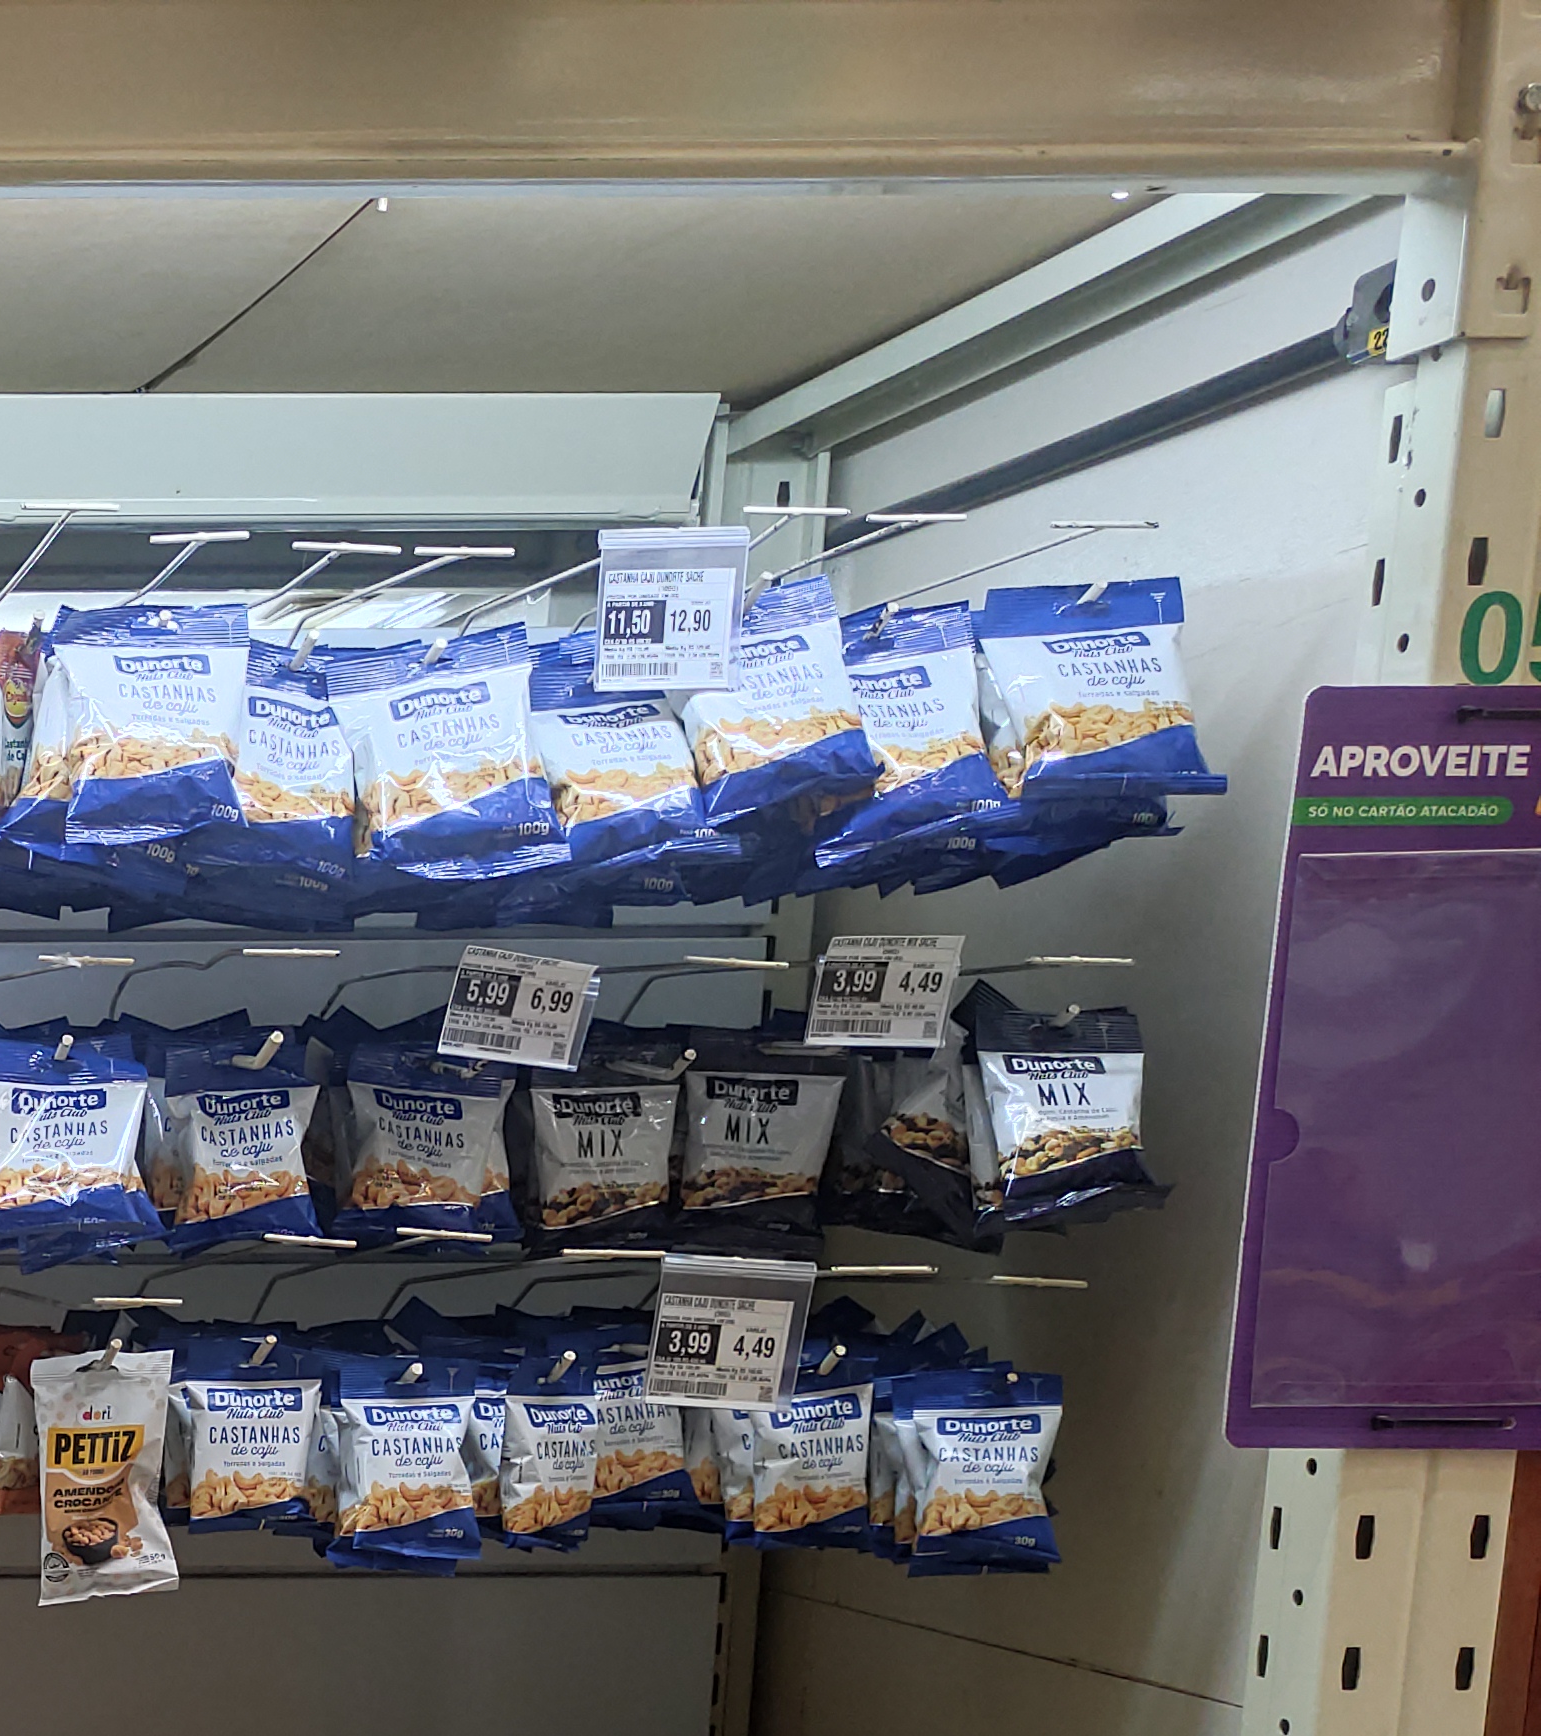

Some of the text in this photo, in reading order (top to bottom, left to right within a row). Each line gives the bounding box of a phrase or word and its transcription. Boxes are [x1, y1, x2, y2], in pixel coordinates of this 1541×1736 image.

[608, 609, 711, 638] 11,50 12,90
[1050, 634, 1143, 653] Dunorte
[1459, 590, 1541, 686] 0
[1057, 658, 1163, 678] CASTANHAS
[118, 683, 217, 702] CASTANHAS
[252, 699, 332, 728] Dunorte
[248, 728, 341, 757] CASTANHAS
[1310, 744, 1531, 777] APROVEITE
[210, 804, 239, 822] 100g
[1308, 802, 1499, 817] SÓ NO CARTÃO ATACADÃO
[517, 820, 550, 837] 100g
[833, 970, 943, 995] 3,99 4,49
[467, 979, 574, 1014] 5,99 6,99
[1010, 1055, 1097, 1073] Dunorte
[381, 1092, 456, 1116] Dunorte
[1037, 1082, 1092, 1107] MIX
[724, 1116, 770, 1146] MIX
[577, 1130, 625, 1159] MIX
[668, 1332, 776, 1361] 3,99 4,49
[214, 1391, 295, 1411] Dunorte
[226, 1407, 285, 1420] Nuts Club
[944, 1416, 1033, 1433] Dunorte
[209, 1426, 301, 1445] CASTANHAS
[371, 1436, 462, 1457] CASTANHAS
[778, 1434, 865, 1460] CASTANHAS
[939, 1445, 1039, 1463] CASTANHAS
